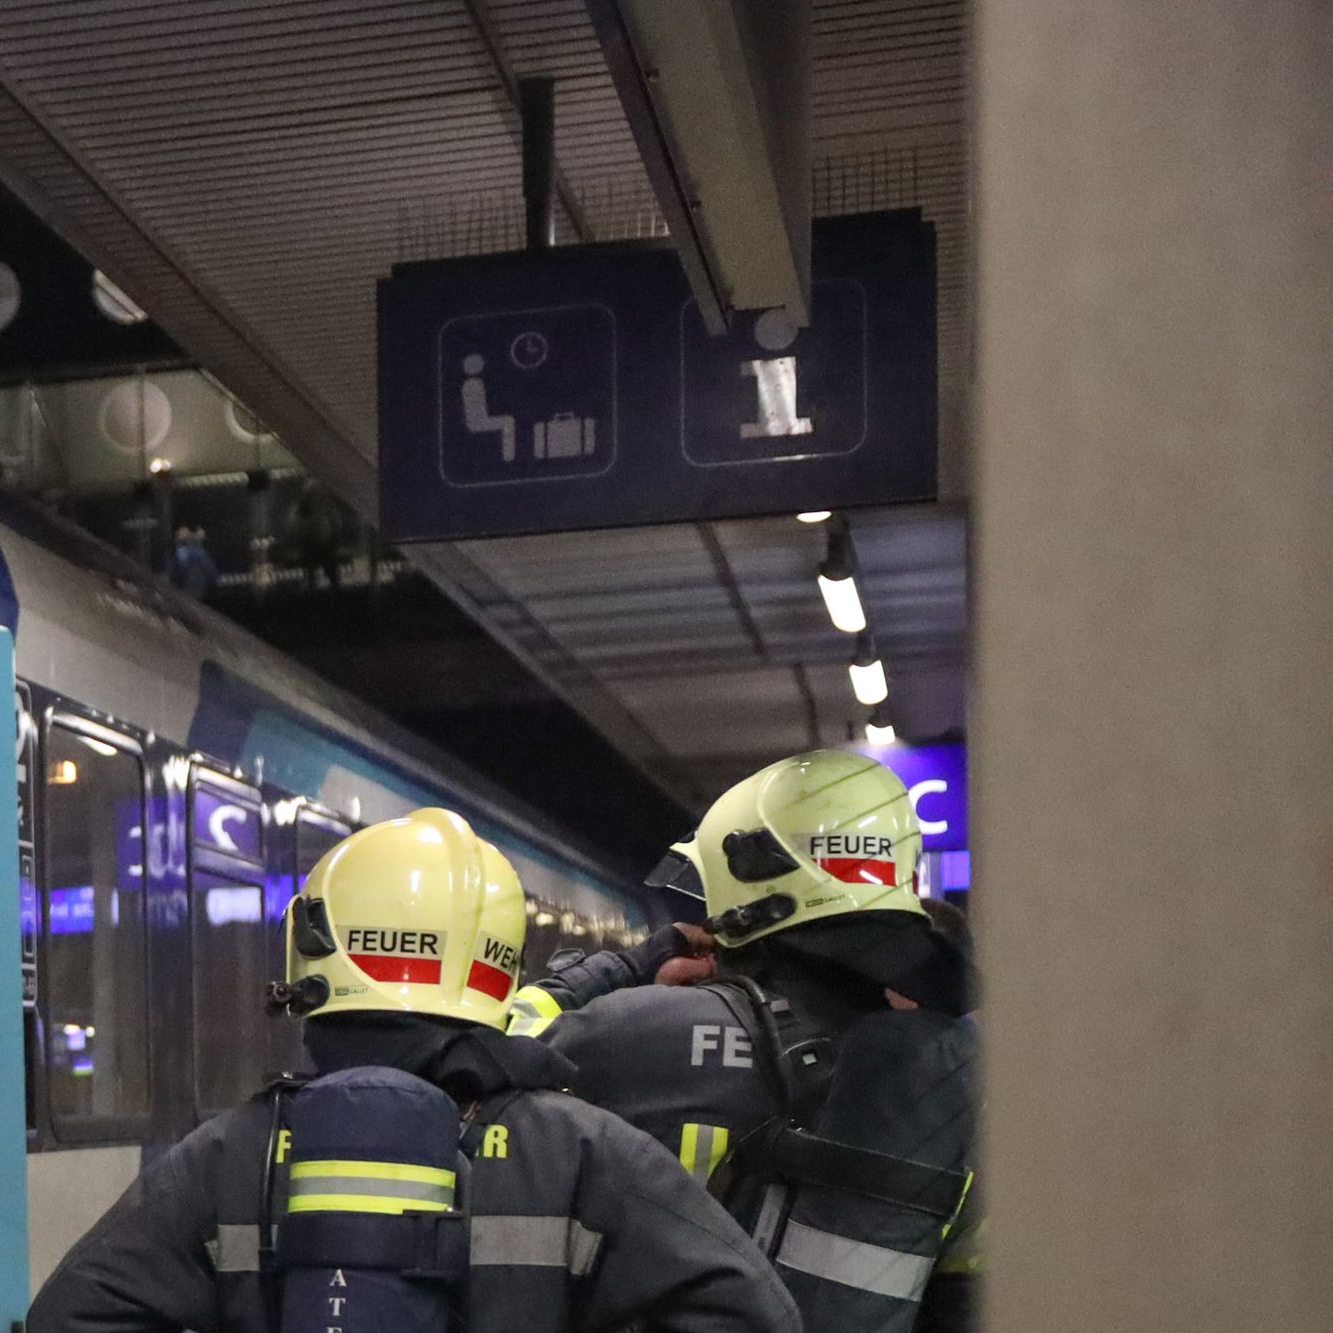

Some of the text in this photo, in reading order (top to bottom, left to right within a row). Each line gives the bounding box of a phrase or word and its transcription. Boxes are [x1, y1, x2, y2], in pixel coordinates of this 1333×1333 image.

[909, 780, 948, 834] C
[808, 834, 893, 858] FEUER
[346, 929, 438, 955] FEUER
